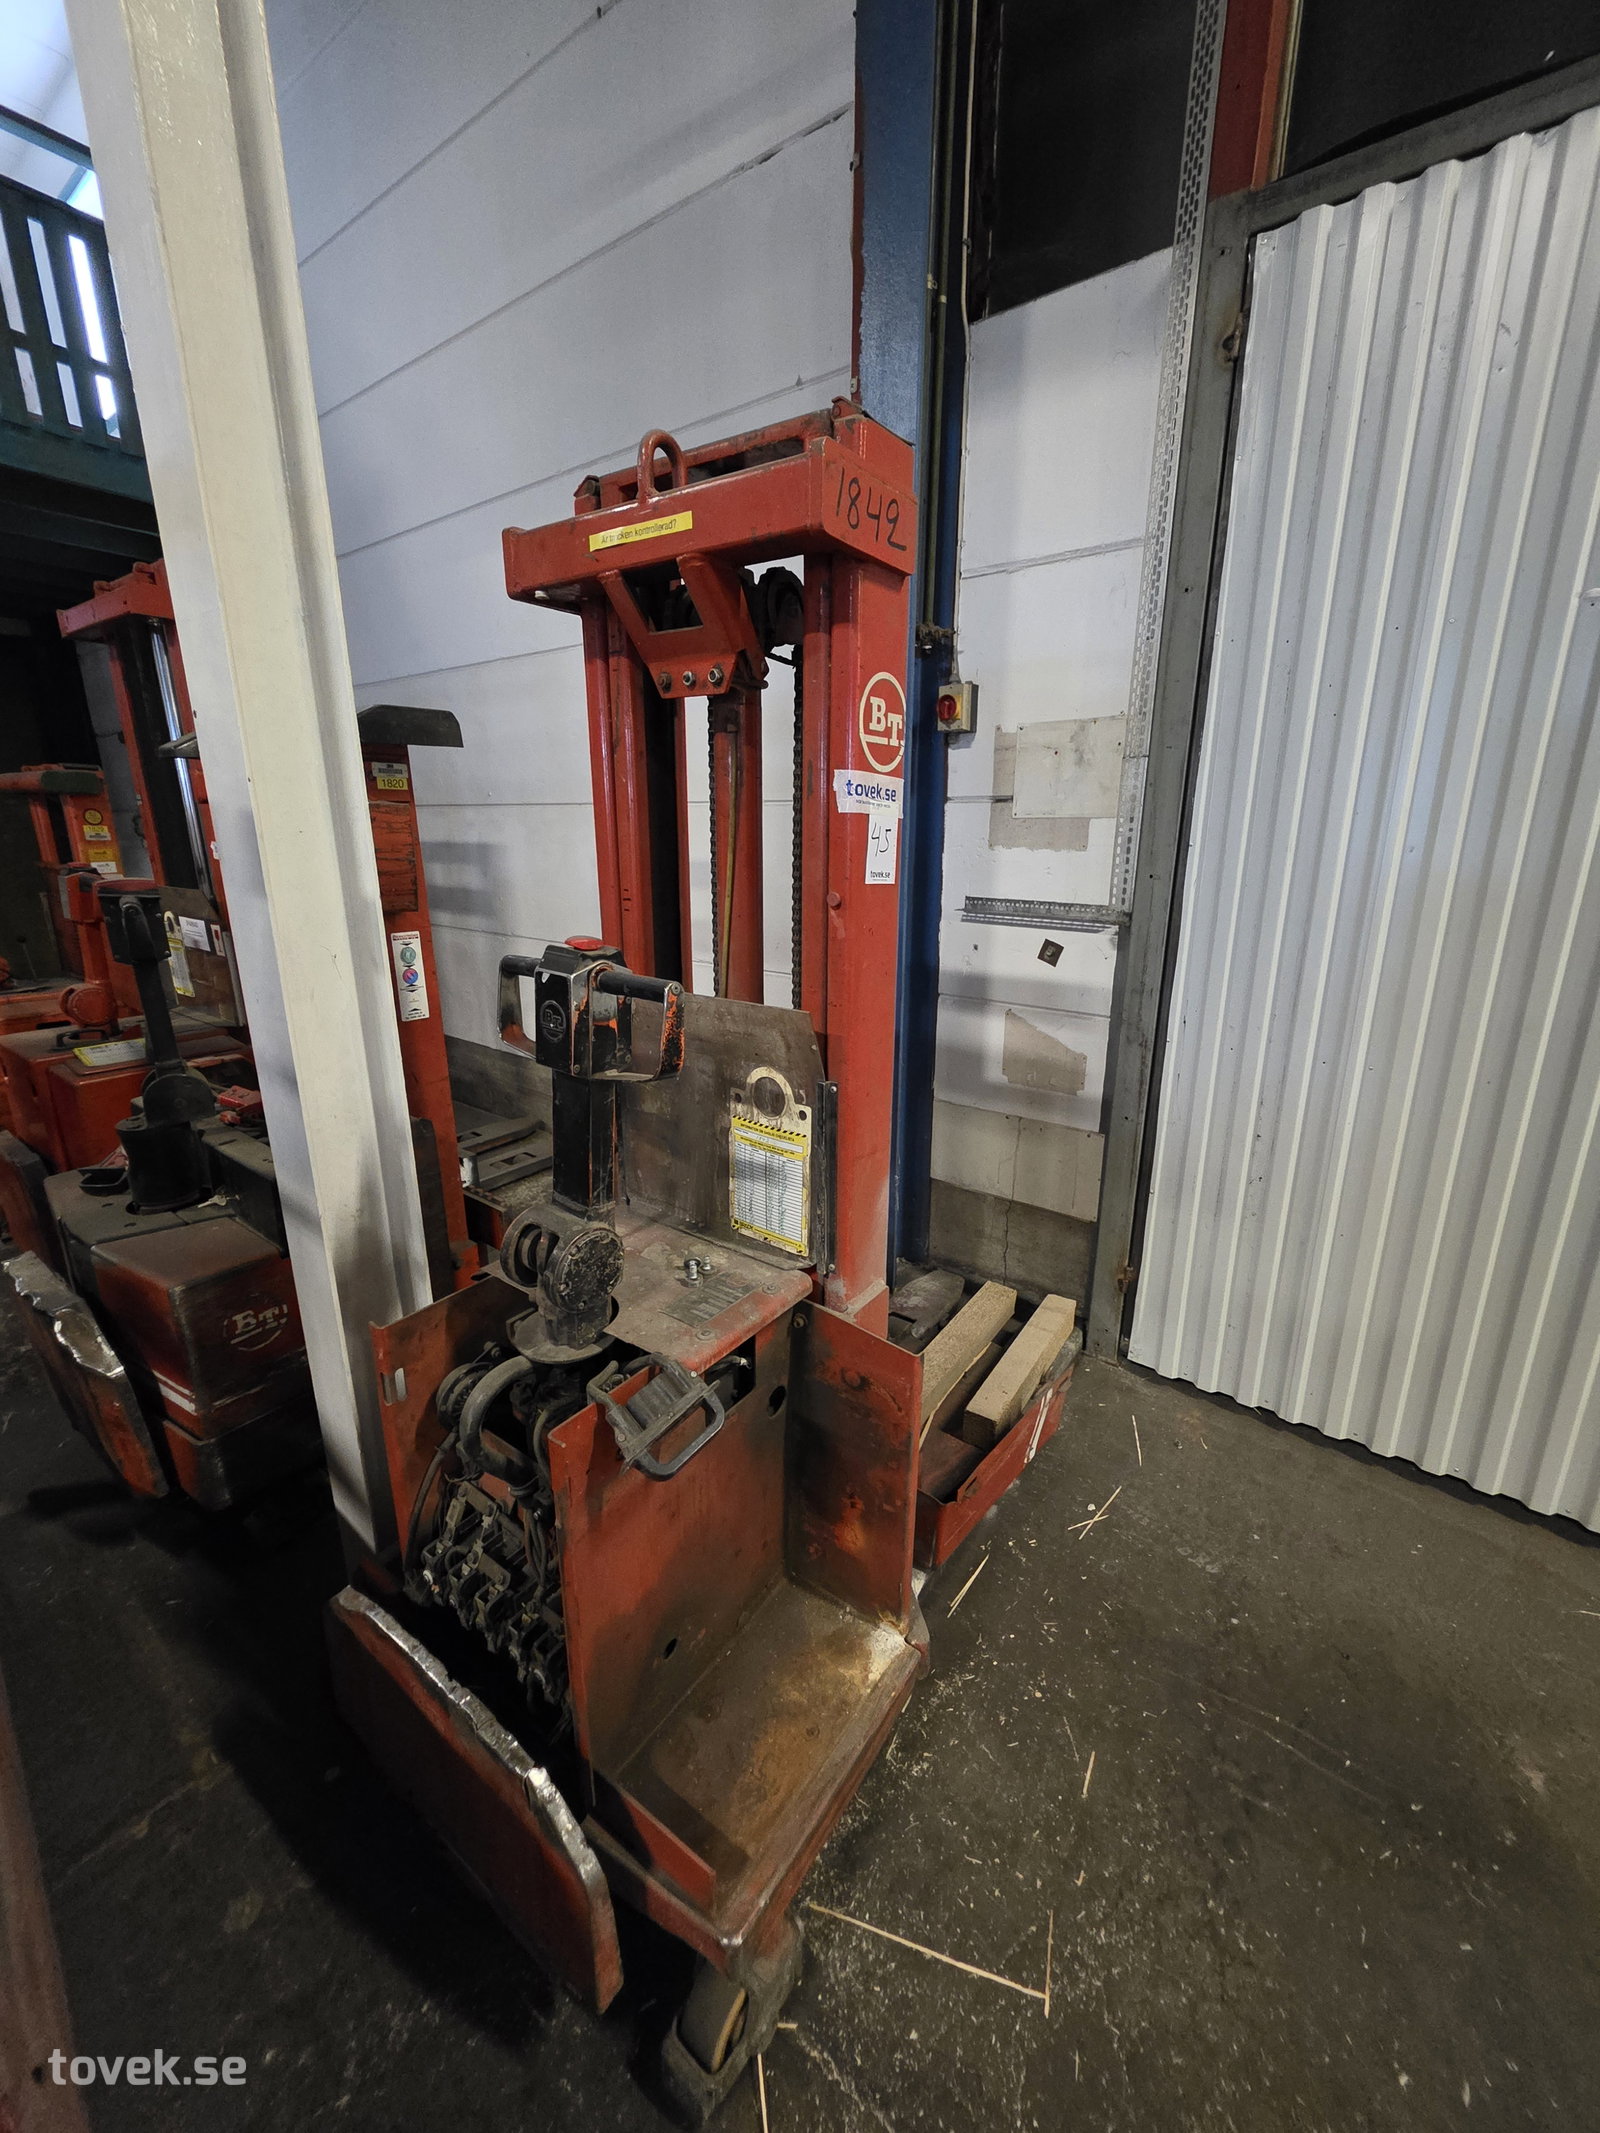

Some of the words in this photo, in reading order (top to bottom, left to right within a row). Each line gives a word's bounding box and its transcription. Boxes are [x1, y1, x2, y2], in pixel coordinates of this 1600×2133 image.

[868, 696, 903, 746] BT
[381, 778, 405, 789] 1820
[846, 779, 897, 803] tovek.se
[871, 822, 892, 857] 45
[870, 870, 891, 879] tovek.se
